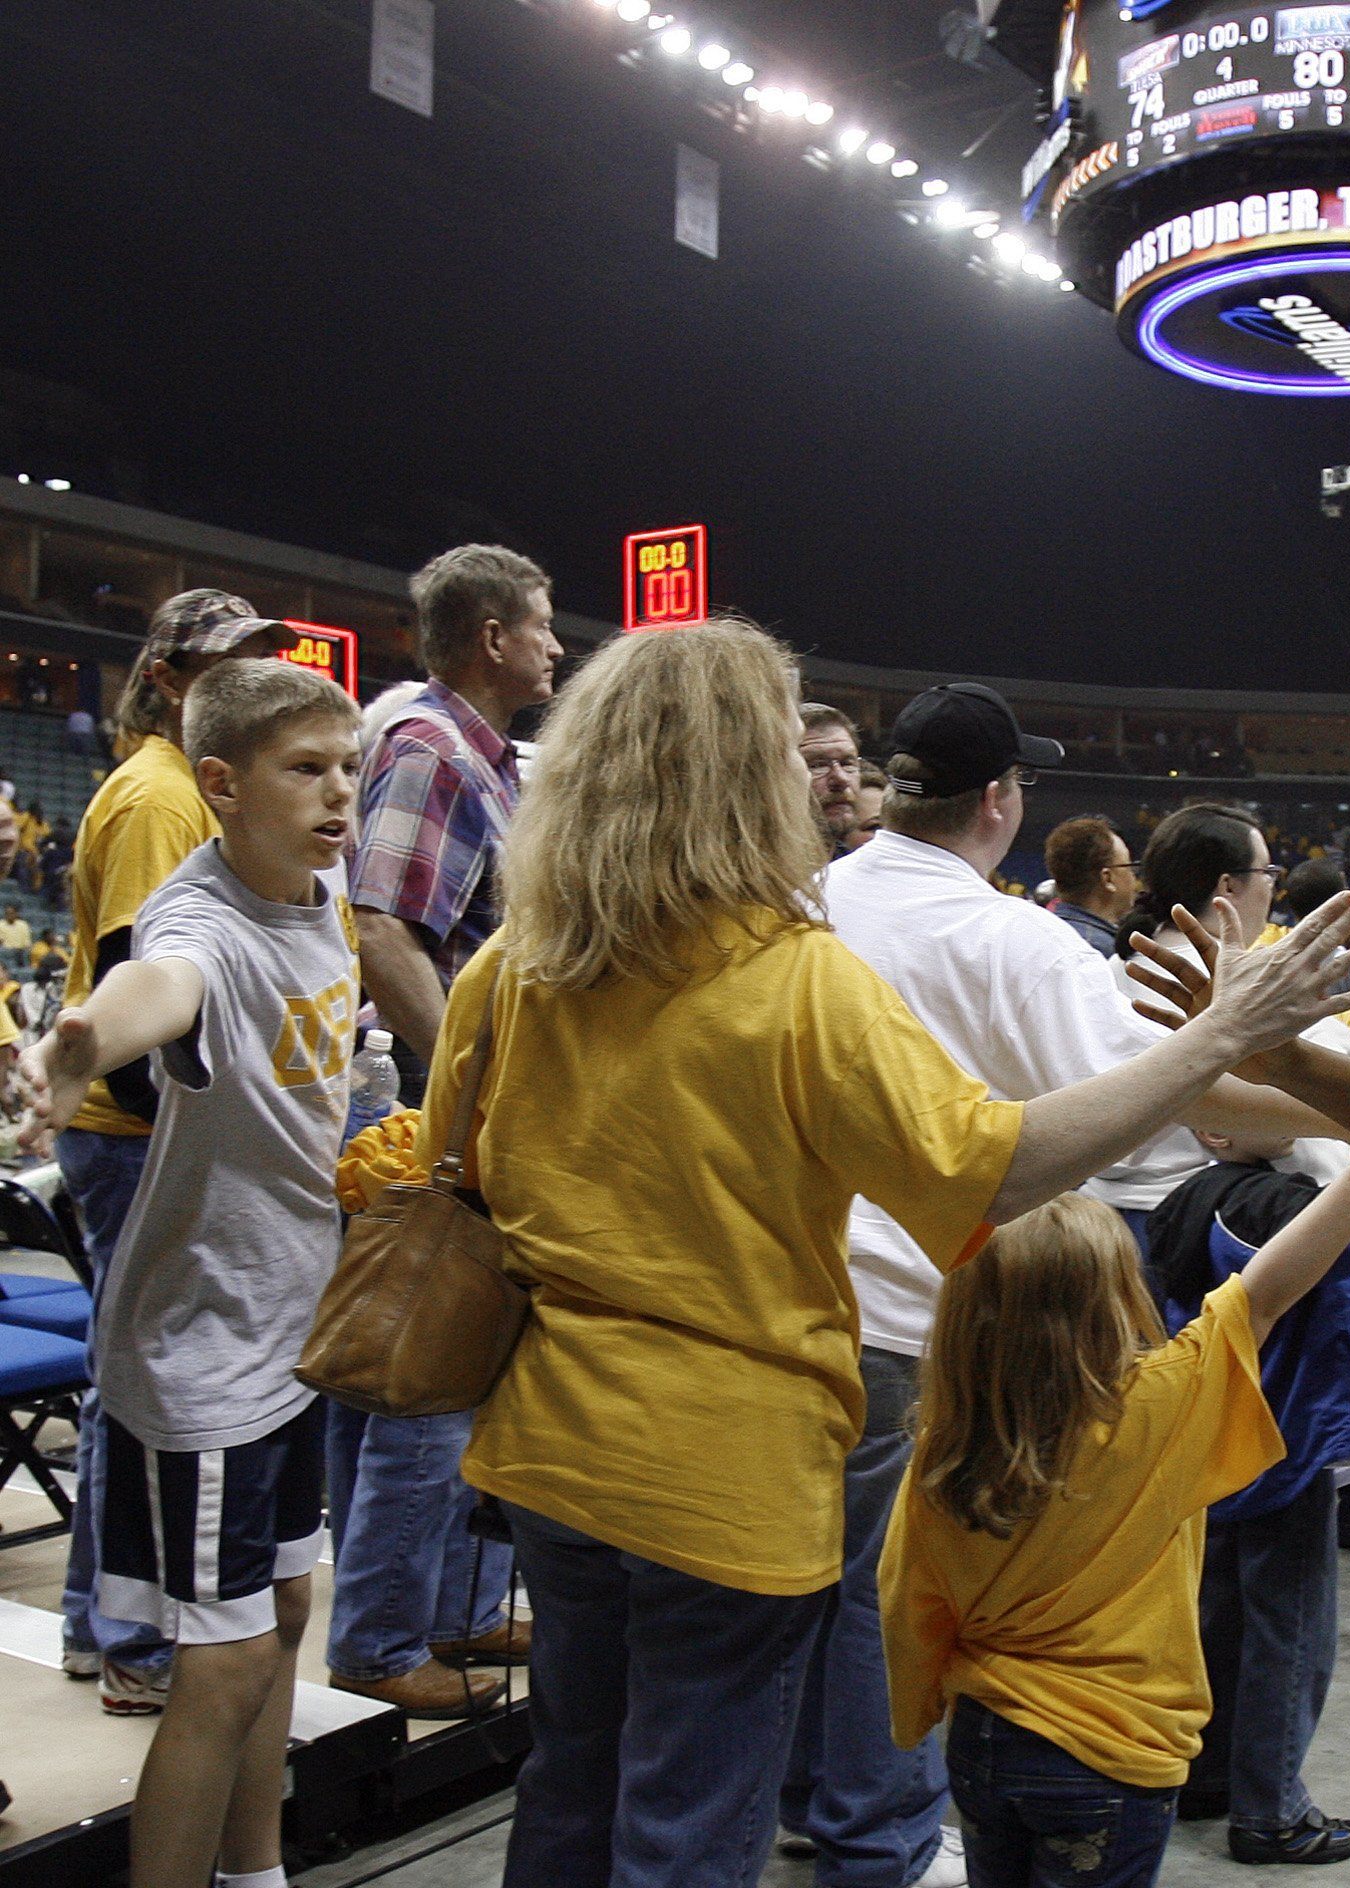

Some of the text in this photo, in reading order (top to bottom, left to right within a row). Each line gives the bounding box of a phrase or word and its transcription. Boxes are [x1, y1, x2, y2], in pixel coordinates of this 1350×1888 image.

[1182, 16, 1269, 58] 0:00.0
[1215, 56, 1233, 81] 4
[1293, 50, 1344, 89] 80
[1128, 83, 1165, 128] 74
[1193, 79, 1259, 105] QUARTER
[1262, 91, 1311, 110] FOULS
[1278, 109, 1294, 130] 5
[1326, 106, 1343, 126] 5
[1126, 133, 1176, 167] 5 2
[646, 569, 692, 619] 00
